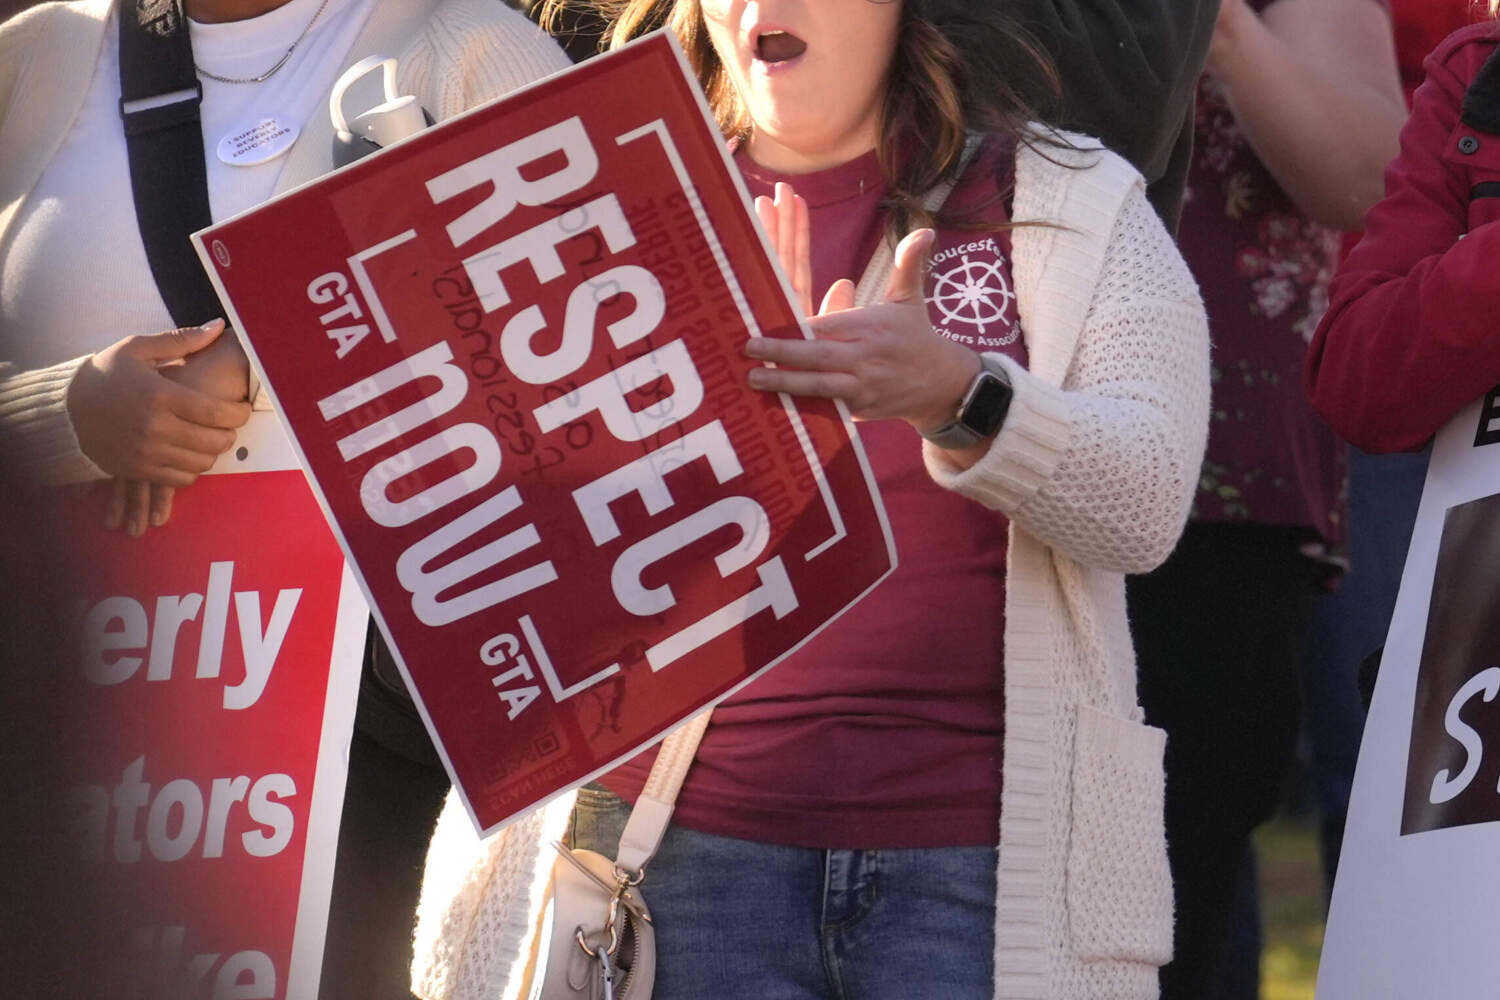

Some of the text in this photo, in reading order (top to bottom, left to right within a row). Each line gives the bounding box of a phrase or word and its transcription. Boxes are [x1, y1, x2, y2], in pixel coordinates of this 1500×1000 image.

[232, 127, 291, 158] EDUCATORS
[306, 271, 371, 360] GTA
[425, 115, 800, 673] RESPECT
[479, 632, 542, 721] GTA
